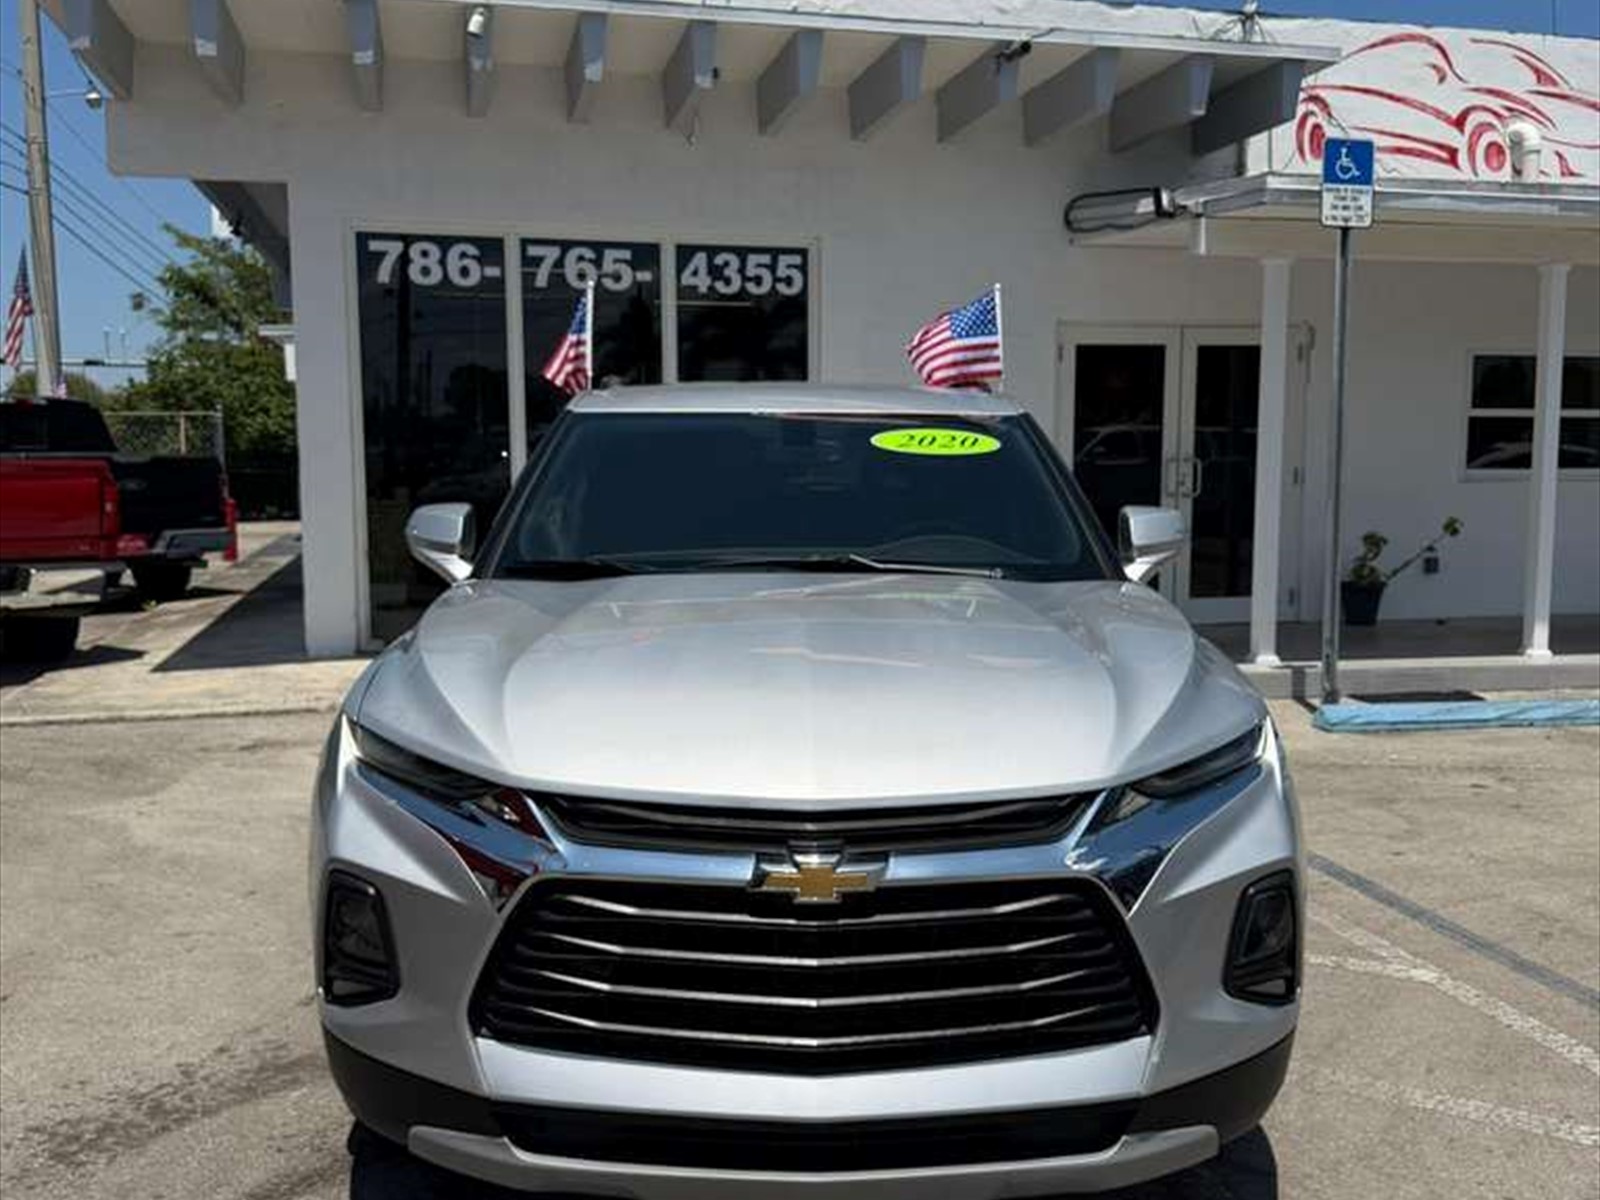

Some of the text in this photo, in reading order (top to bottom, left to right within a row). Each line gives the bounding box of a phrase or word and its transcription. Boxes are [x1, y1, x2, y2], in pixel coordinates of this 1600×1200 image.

[368, 239, 803, 295] 786- 765- 4355
[897, 433, 980, 449] 2020
